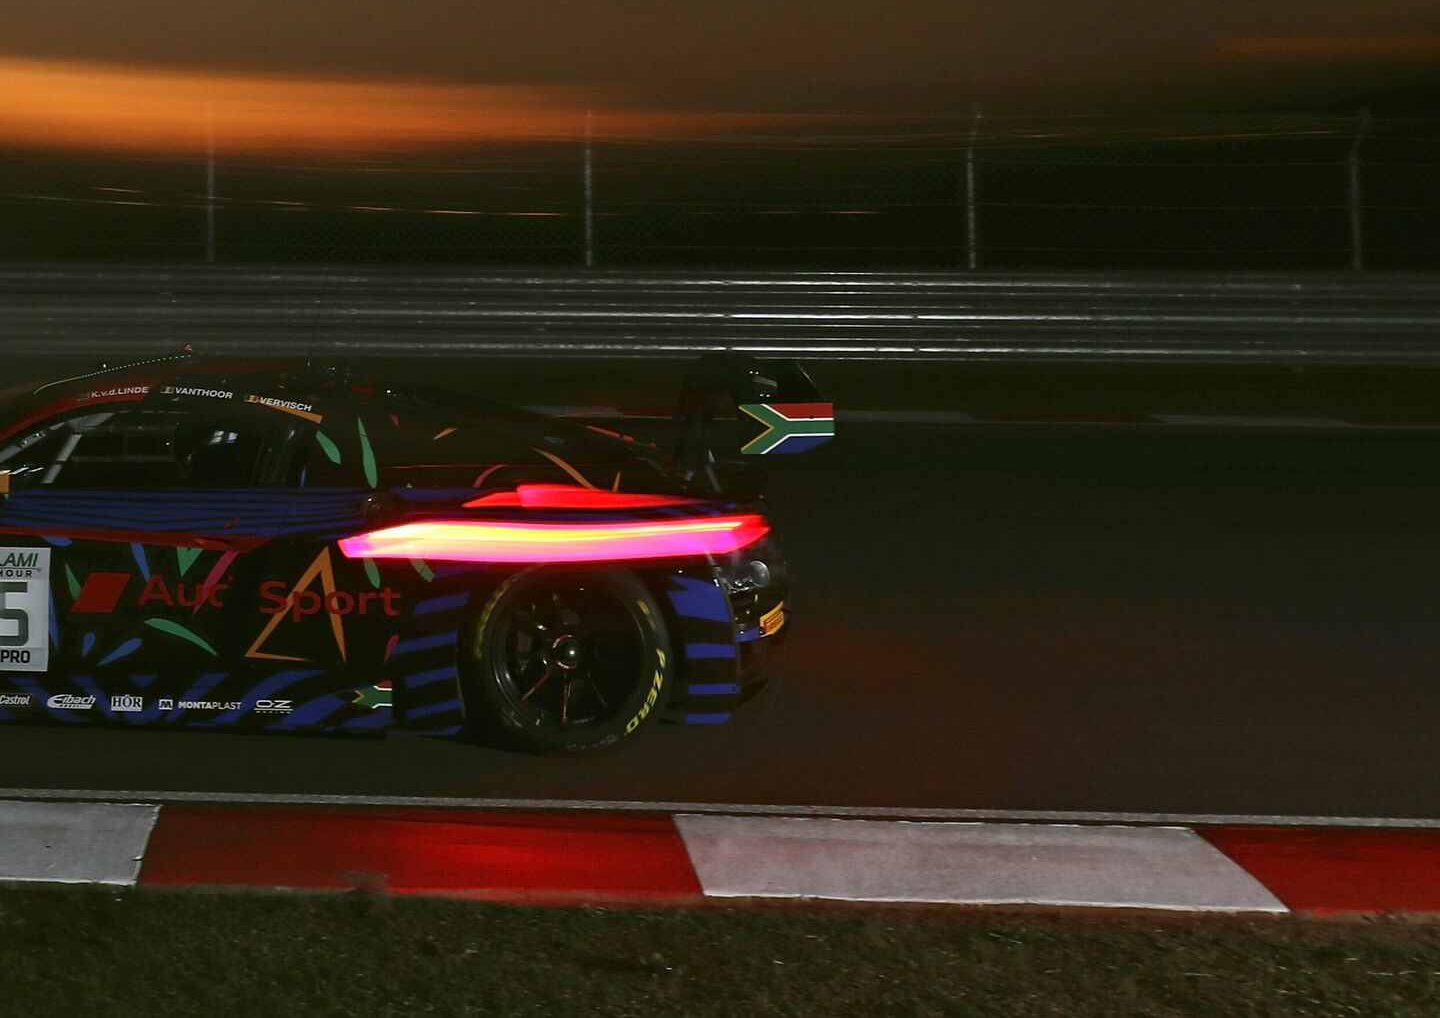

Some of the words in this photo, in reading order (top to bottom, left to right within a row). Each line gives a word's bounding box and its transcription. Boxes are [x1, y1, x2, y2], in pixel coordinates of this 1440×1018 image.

[175, 387, 233, 399] VANTHOOR
[260, 397, 312, 411] VERVISCH
[258, 579, 401, 623] Sport
[0, 650, 31, 663] PRO
[46, 693, 97, 710] Eibach
[178, 701, 242, 710] MONTAPLAST
